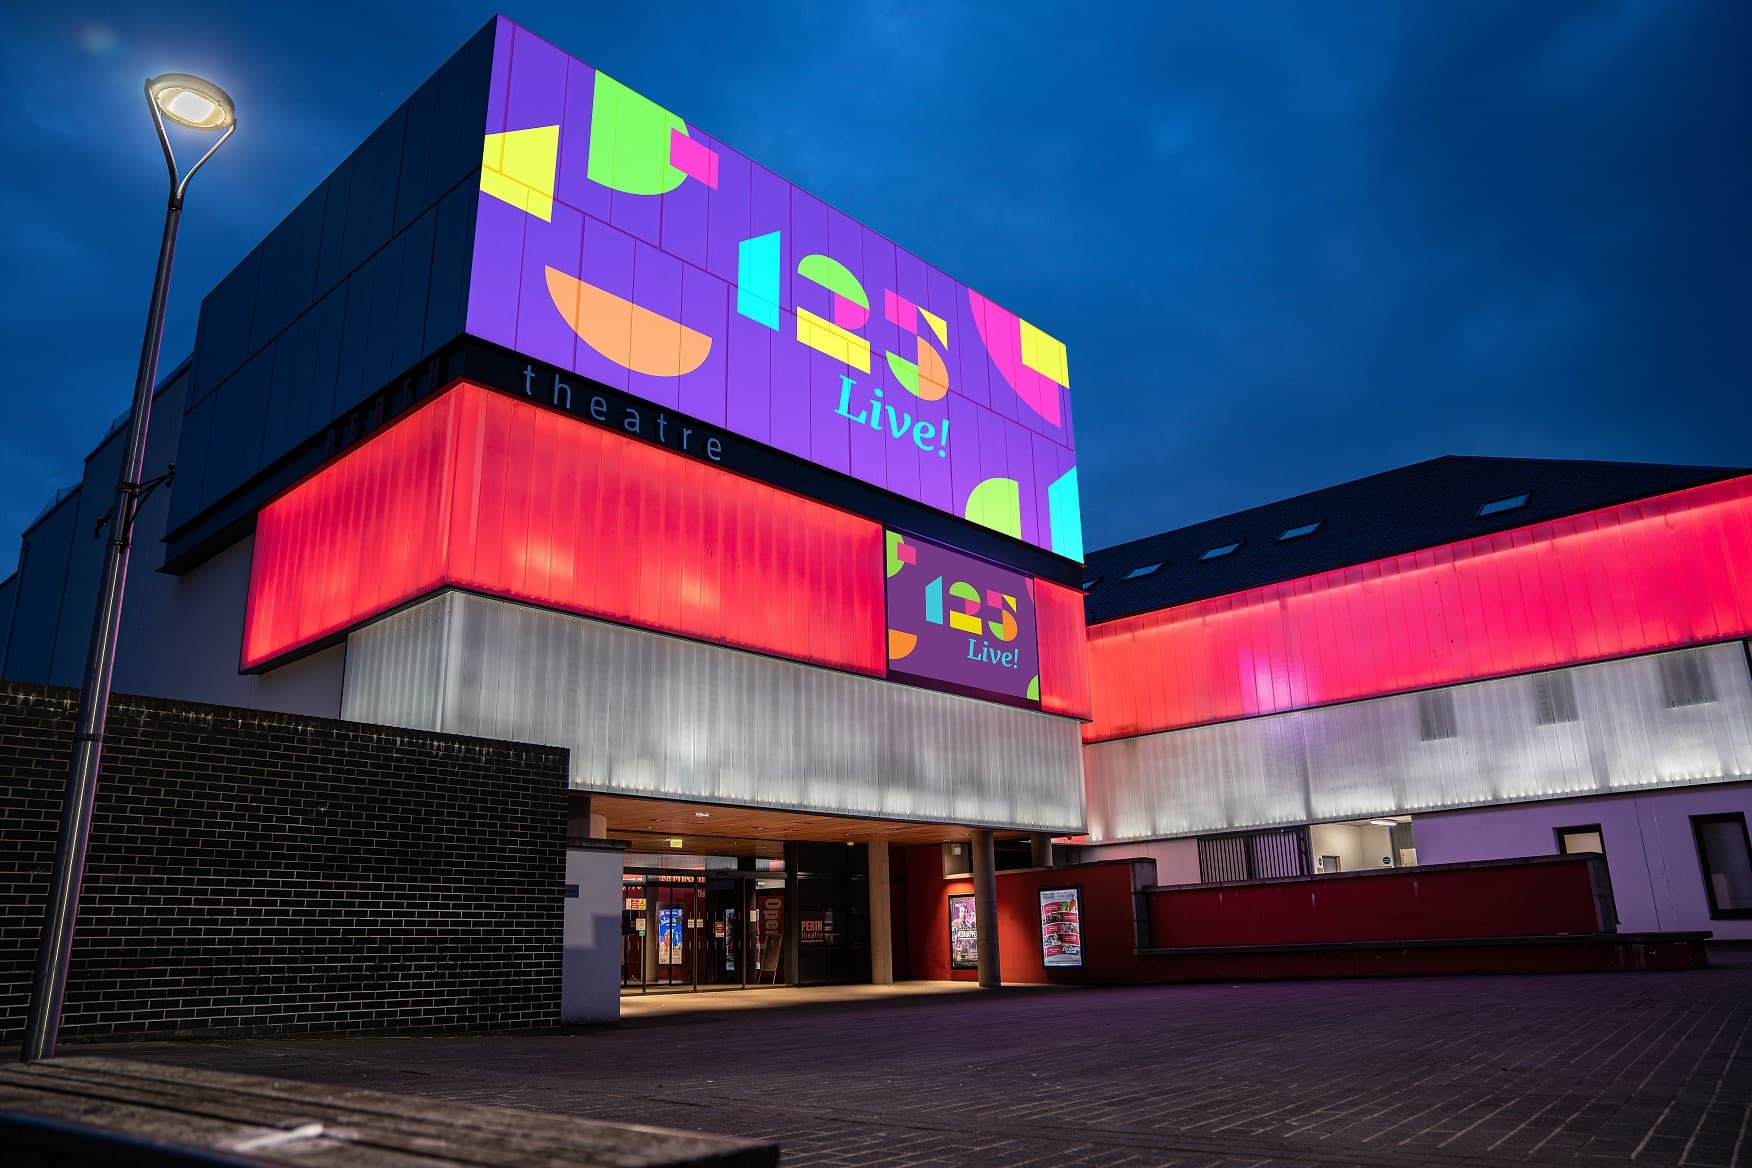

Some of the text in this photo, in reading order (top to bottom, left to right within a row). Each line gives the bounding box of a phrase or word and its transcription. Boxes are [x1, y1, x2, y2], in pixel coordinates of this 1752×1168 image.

[737, 231, 949, 401] 125
[523, 364, 722, 461] theatre
[835, 374, 950, 458] Live!
[925, 575, 1018, 642] 125
[967, 638, 1019, 669] Live!
[800, 931, 824, 940] theatre
[801, 920, 823, 931] PERTH
